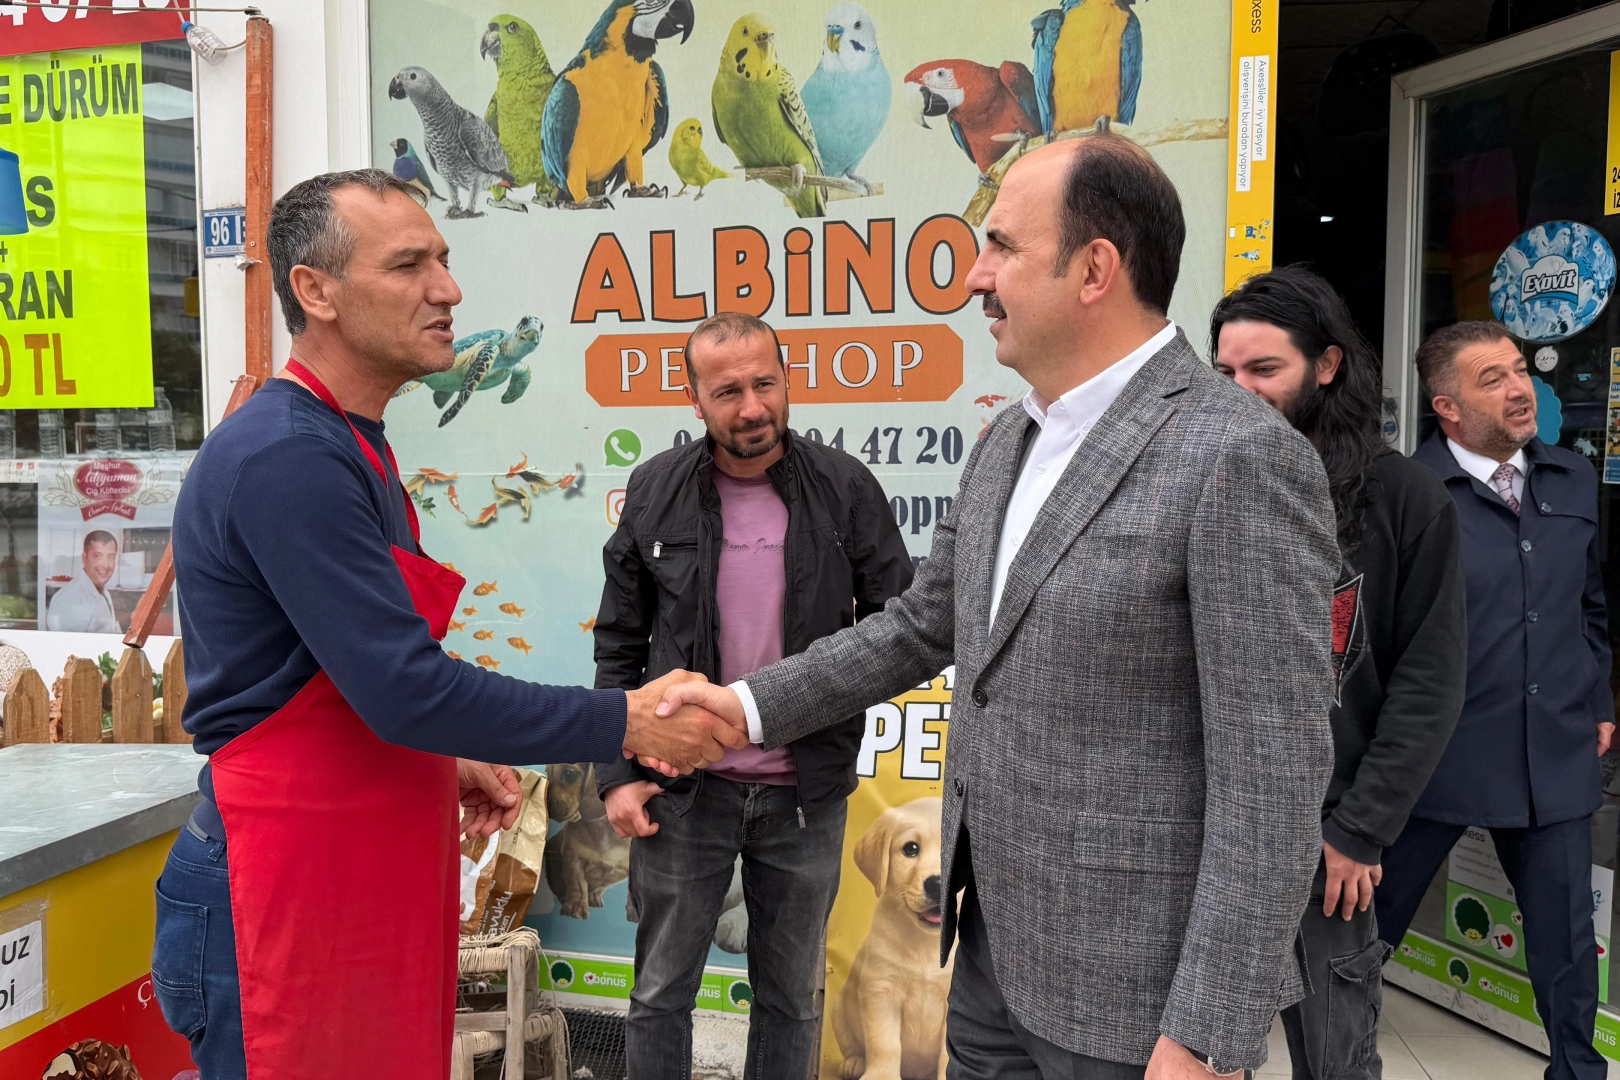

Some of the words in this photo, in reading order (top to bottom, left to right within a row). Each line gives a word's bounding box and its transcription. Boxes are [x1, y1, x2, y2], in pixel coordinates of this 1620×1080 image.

[1251, 0, 1262, 33] xess
[23, 54, 139, 123] DÜRÜM
[1241, 61, 1252, 110] alışverişini
[1257, 60, 1267, 104] Axessliler
[1241, 111, 1251, 151] buradan
[1255, 108, 1266, 120] iyi
[1254, 121, 1264, 156] yaşıyor
[1237, 151, 1248, 187] yapıyor
[210, 216, 230, 246] 96
[1523, 269, 1577, 294] Exovit
[24, 333, 77, 396] TL
[619, 346, 685, 392] PE
[780, 339, 925, 390] HOP
[860, 426, 903, 465] 47
[915, 425, 964, 465] 20
[856, 701, 952, 781] PE
[488, 890, 513, 938] avuklu
[697, 986, 721, 999] nus
[1593, 1027, 1618, 1047] nus
